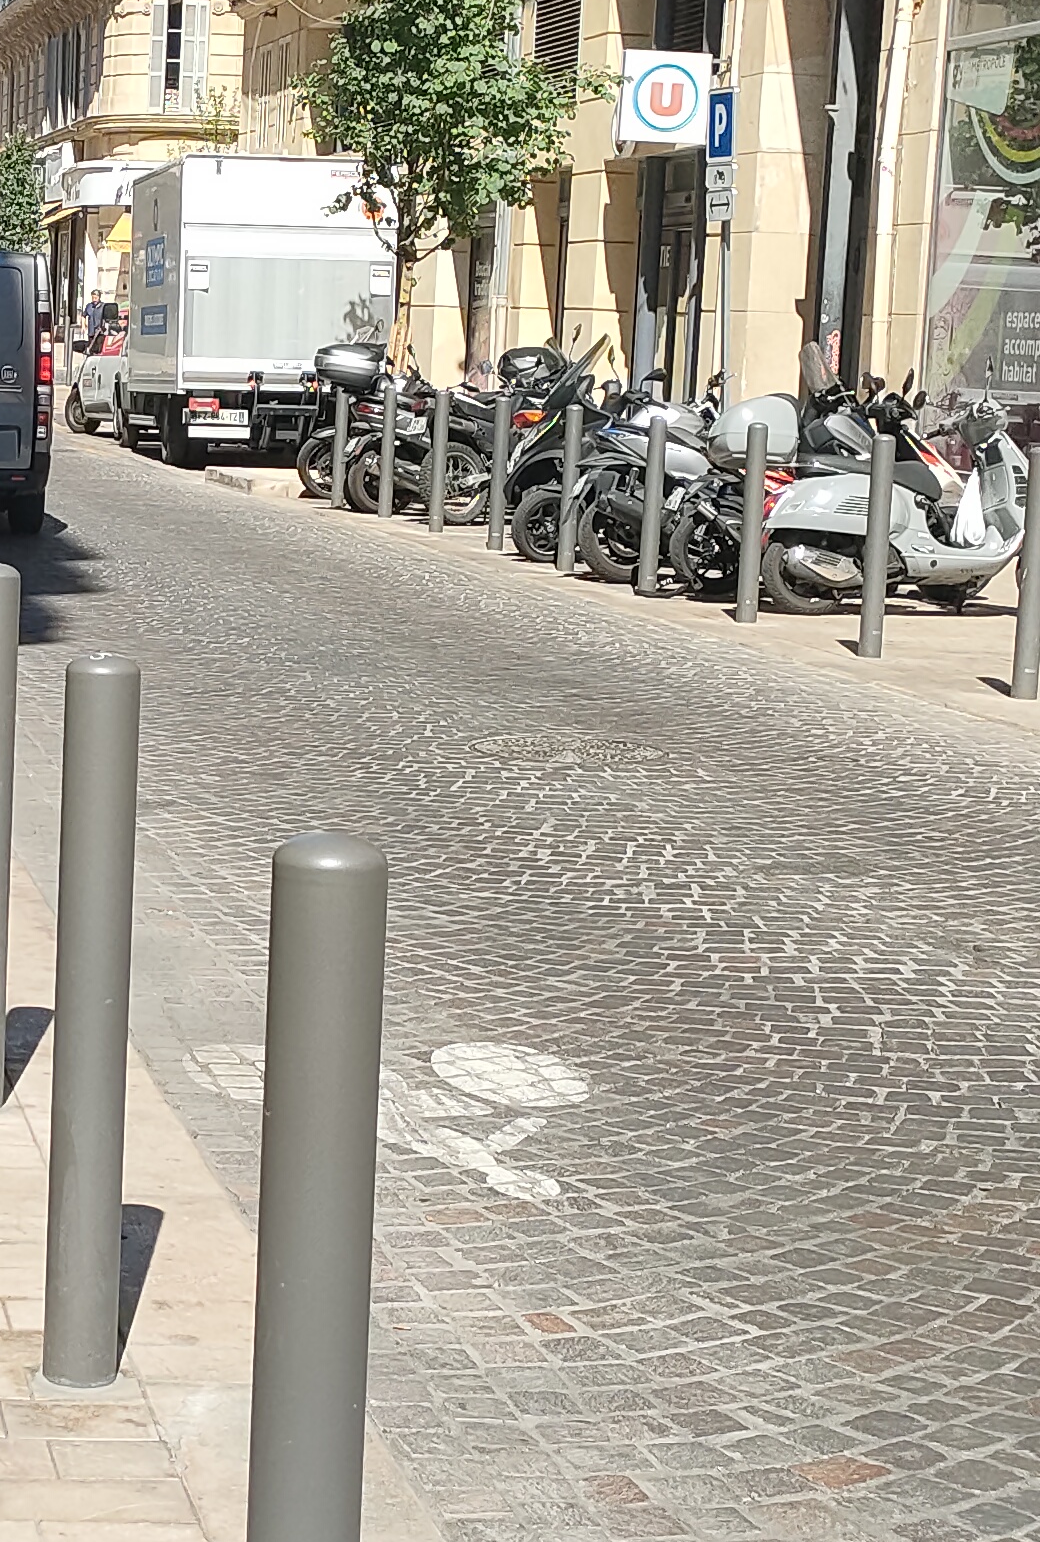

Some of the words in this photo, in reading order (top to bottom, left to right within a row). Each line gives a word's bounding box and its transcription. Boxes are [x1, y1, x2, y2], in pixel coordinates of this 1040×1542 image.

[650, 81, 684, 117] U
[714, 103, 728, 148] P
[1006, 311, 1040, 333] espace
[1001, 360, 1037, 384] habitat
